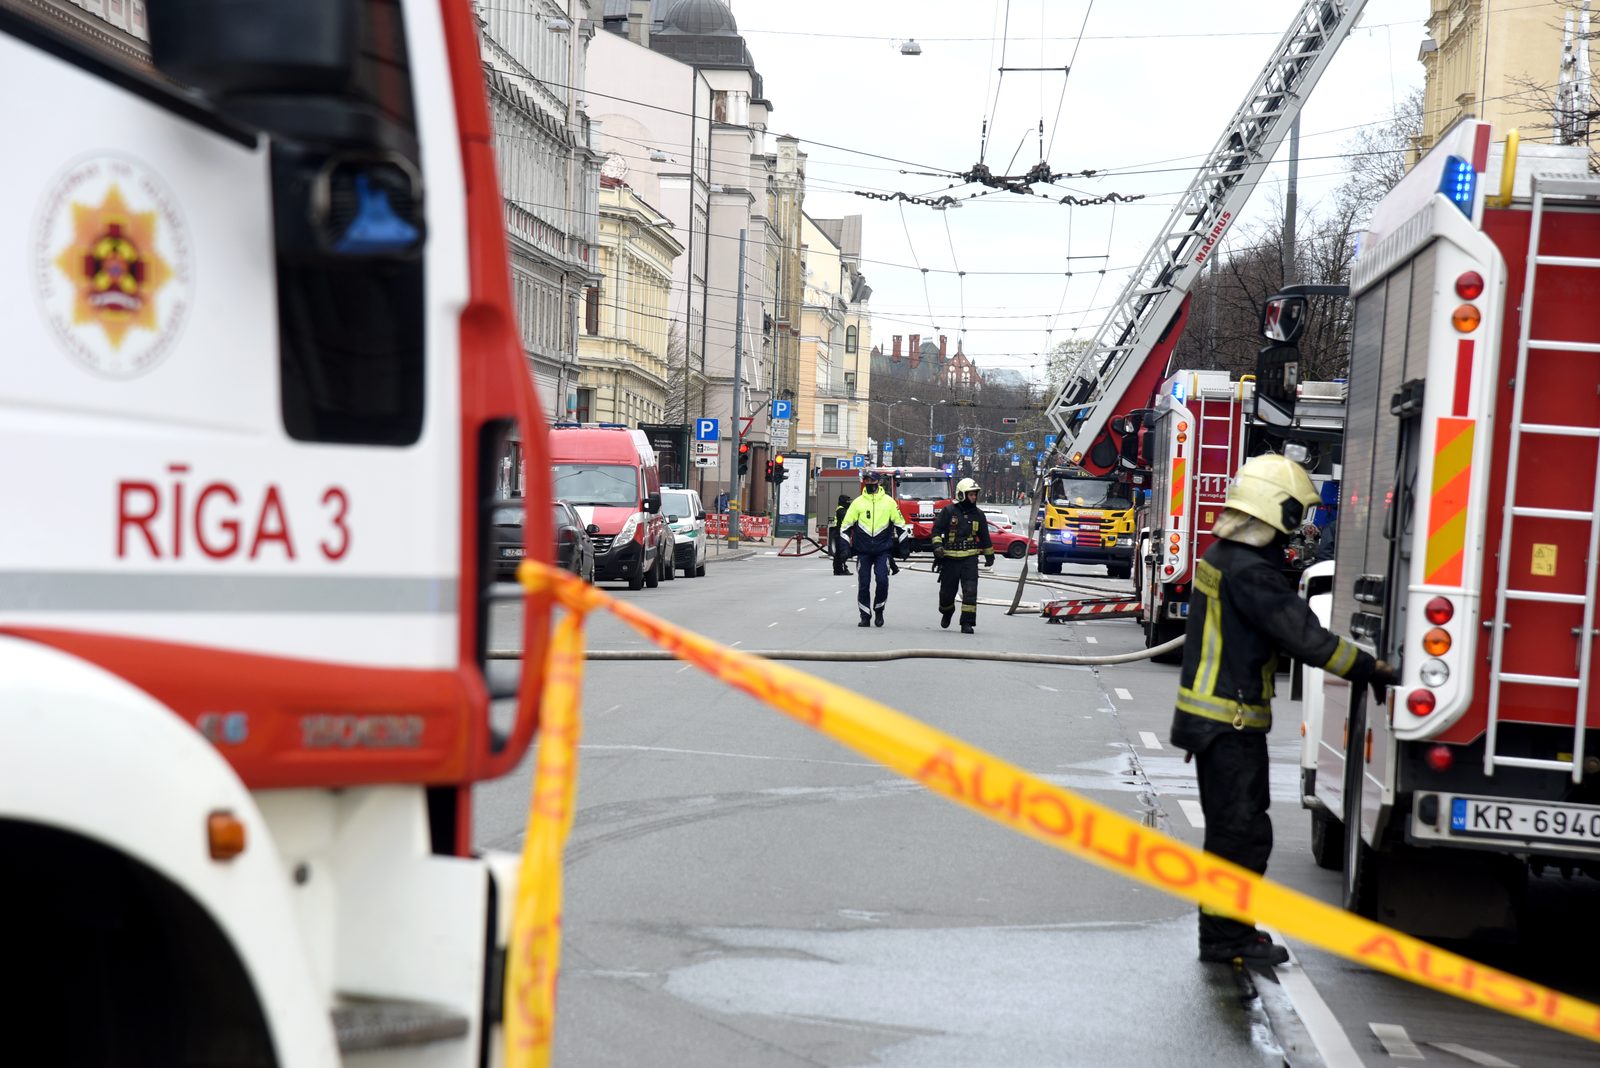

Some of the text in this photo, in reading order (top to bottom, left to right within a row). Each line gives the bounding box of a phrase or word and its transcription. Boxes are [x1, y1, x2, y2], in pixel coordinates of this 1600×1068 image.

[1195, 211, 1231, 263] MAGIRUS
[776, 402, 787, 416] P
[701, 421, 714, 438] P
[840, 462, 848, 470] P
[855, 456, 862, 466] P
[117, 464, 351, 561] RĪGA 3
[1473, 804, 1600, 837] KR-6940
